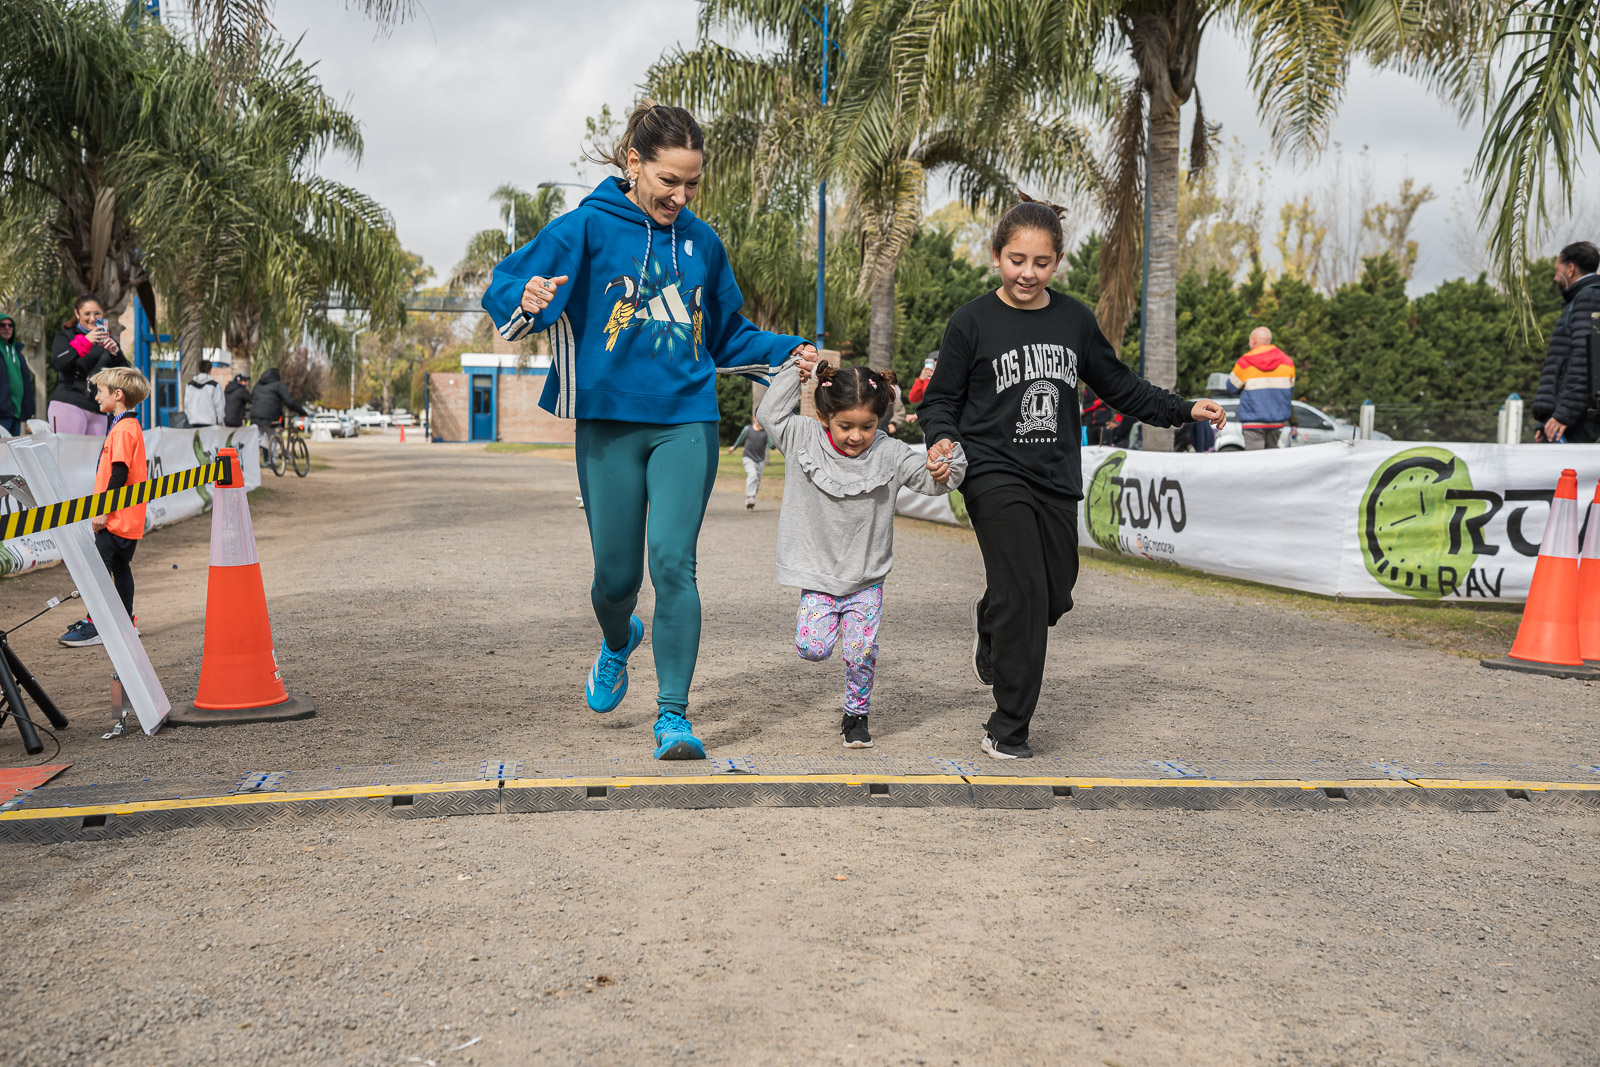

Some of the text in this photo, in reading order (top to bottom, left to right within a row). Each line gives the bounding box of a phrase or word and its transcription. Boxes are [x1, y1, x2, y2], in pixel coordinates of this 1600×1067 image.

[992, 343, 1078, 394] LOS ANGELES
[1032, 395, 1053, 417] LA
[1437, 566, 1505, 598] RAV
